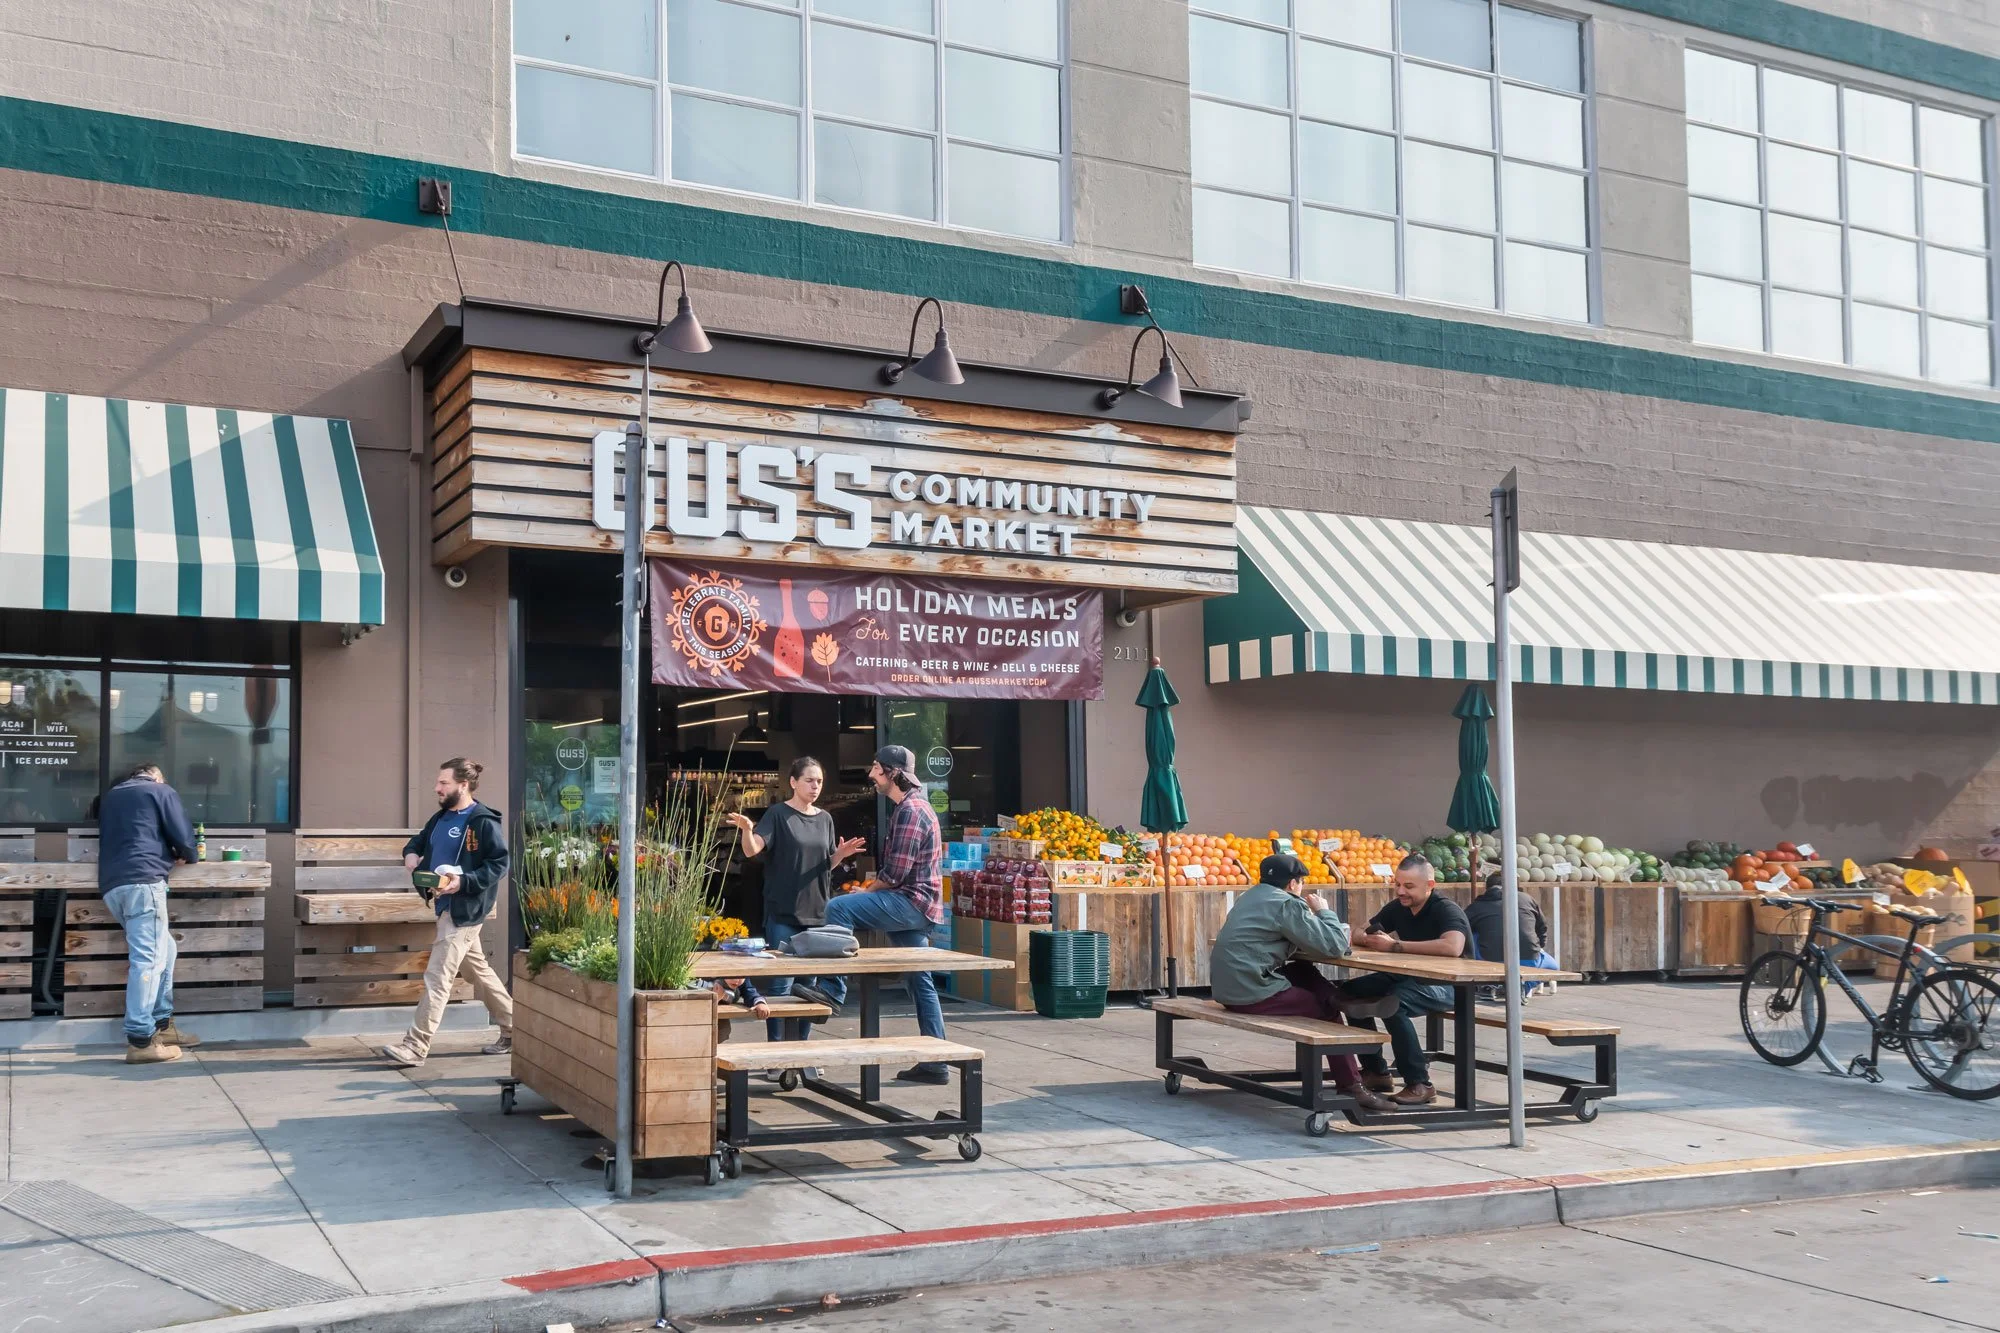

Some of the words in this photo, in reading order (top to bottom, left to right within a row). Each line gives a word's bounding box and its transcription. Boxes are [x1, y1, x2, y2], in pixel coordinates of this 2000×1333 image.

[592, 430, 872, 549] GUS'S
[889, 471, 1156, 522] COMMUNITY
[890, 511, 1079, 555] MARKET
[682, 587, 726, 626] CELEBRATE
[728, 593, 751, 630] FAMILY
[855, 586, 974, 616] HOLIDAY
[987, 595, 1078, 621] MEALS
[711, 615, 722, 633] G
[856, 617, 889, 640] For
[899, 623, 968, 644] EVERY
[977, 627, 1080, 648] OCCASION
[688, 636, 707, 656] THIS
[708, 639, 745, 659] SEASON
[1114, 646, 1148, 661] 2111
[855, 656, 908, 668] CATERING
[921, 659, 948, 670] BEER
[952, 661, 959, 670] &
[963, 661, 990, 672] WINE
[1002, 663, 1025, 673] DELI
[1030, 663, 1037, 672] &
[1041, 663, 1080, 674] CHEESE
[891, 673, 920, 683] ORDER
[922, 675, 953, 684] ONLINE
[956, 677, 966, 685] AT
[968, 677, 1047, 687] GUSSMARKET.COM
[1, 720, 24, 728] ACAI
[46, 725, 68, 733] WIFI
[15, 757, 32, 765] ICE
[34, 757, 69, 765] CREAM
